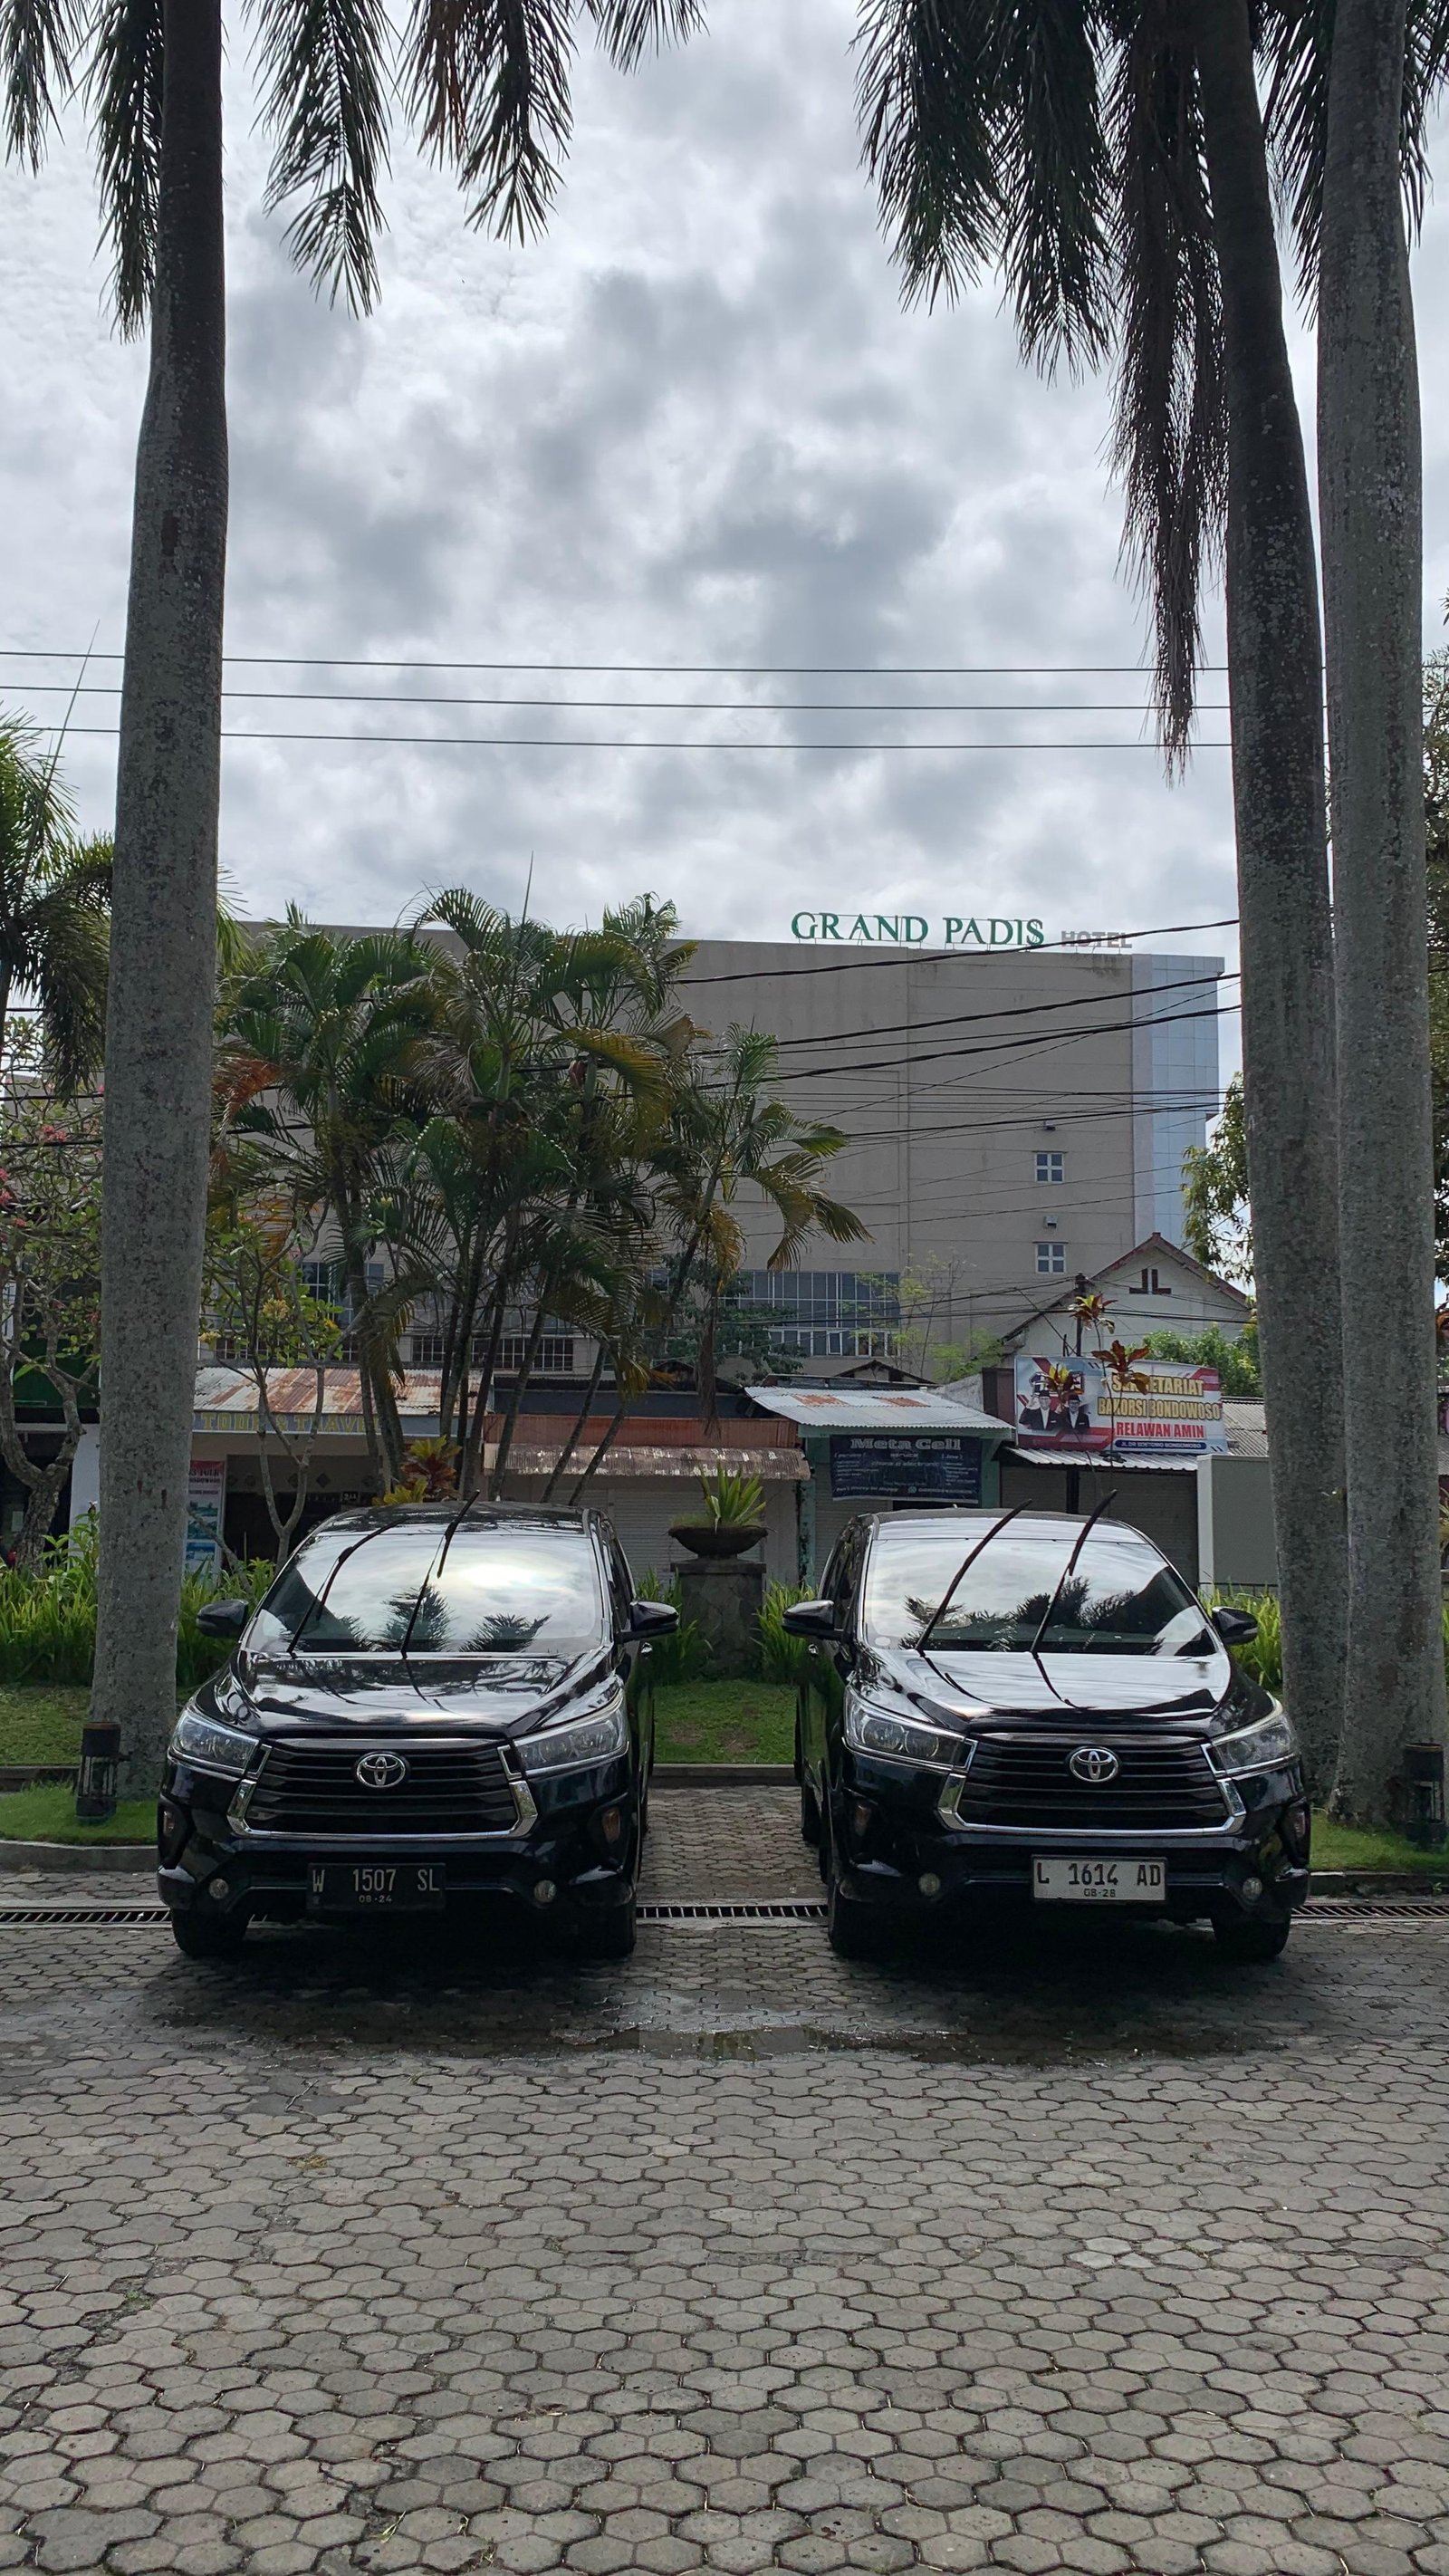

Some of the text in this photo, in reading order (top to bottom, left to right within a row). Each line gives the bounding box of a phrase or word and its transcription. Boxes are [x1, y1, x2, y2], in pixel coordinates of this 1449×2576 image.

[792, 912, 1133, 949] GRAND PADIS HOTEL
[1097, 1398, 1222, 1420] BAKORSI BONDOWOSO
[1116, 1421, 1205, 1438] RELAWAN AMIN
[849, 1438, 962, 1450] Meta Cell
[312, 1869, 440, 1892] W 1507 SL
[1037, 1862, 1161, 1886] L 1614 AD
